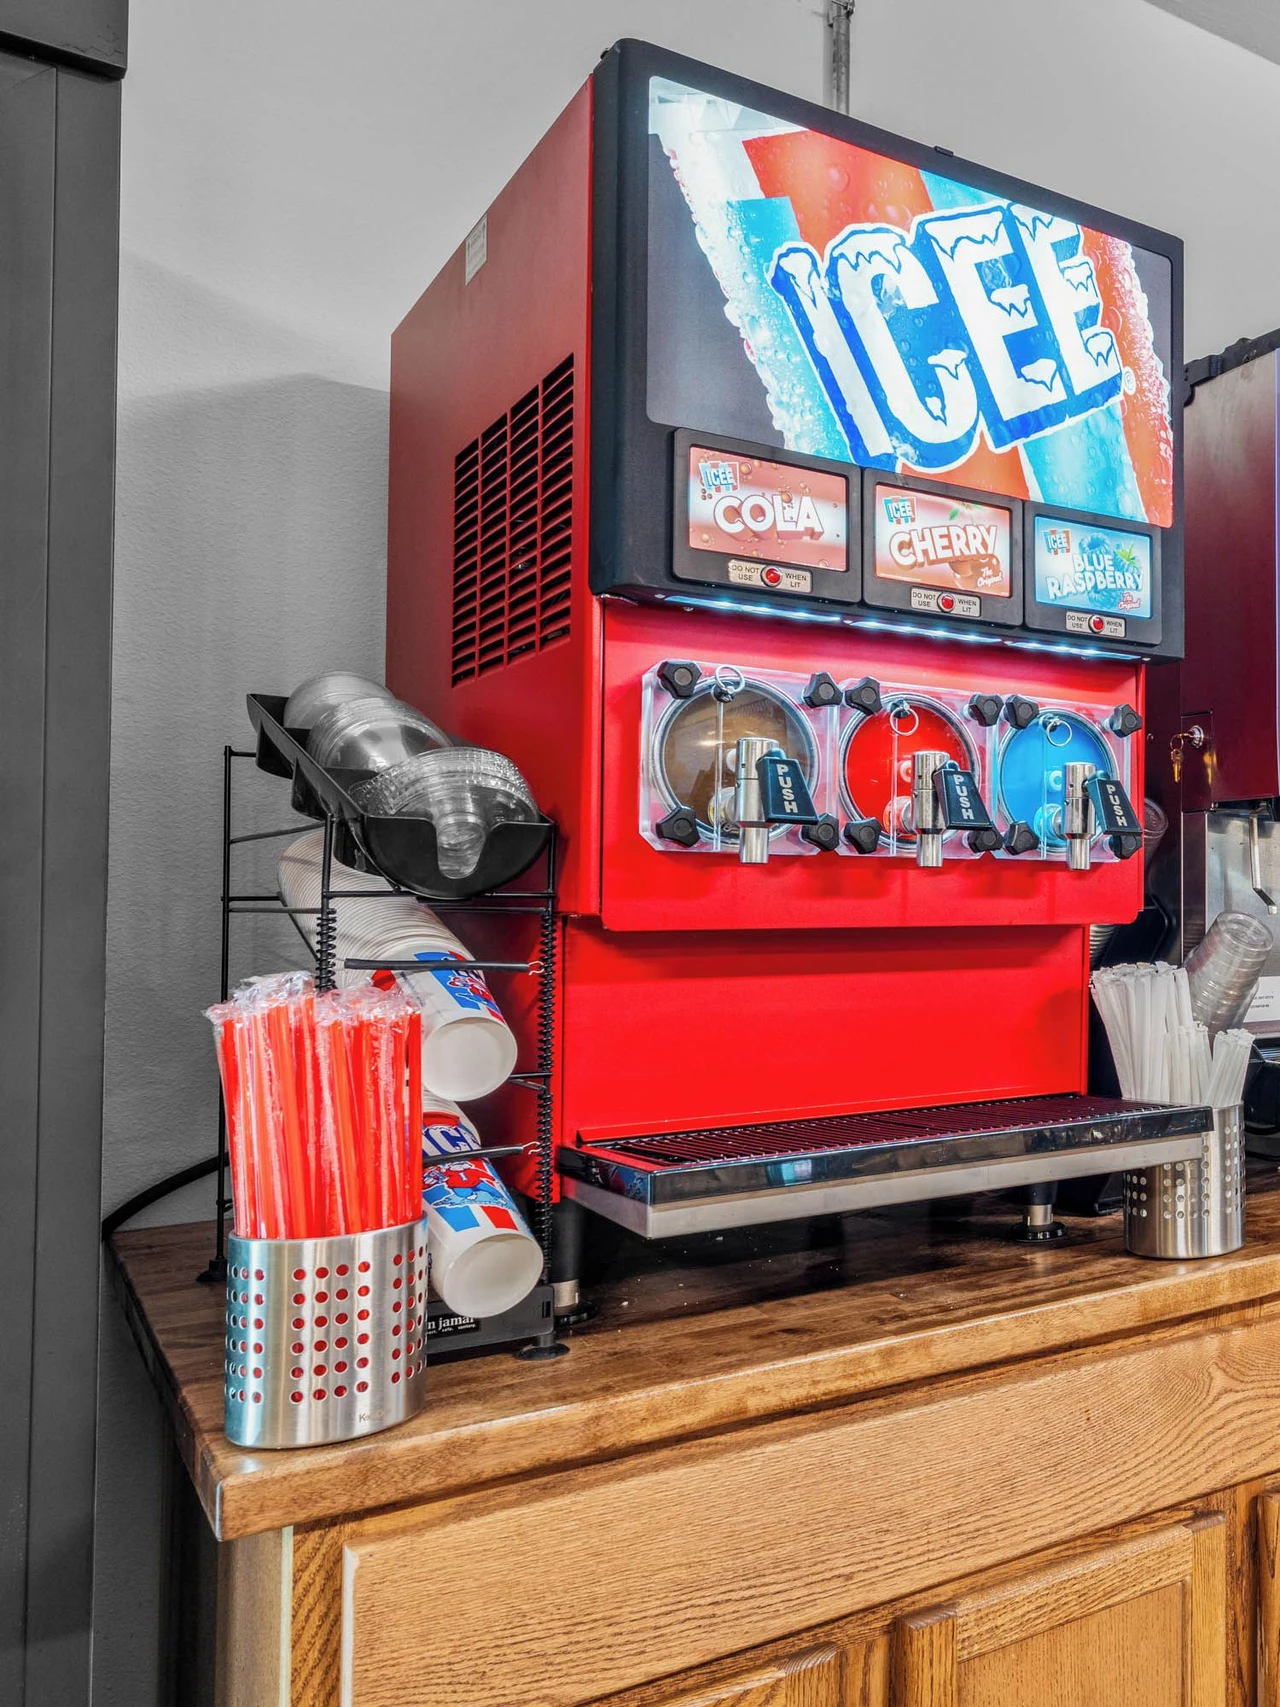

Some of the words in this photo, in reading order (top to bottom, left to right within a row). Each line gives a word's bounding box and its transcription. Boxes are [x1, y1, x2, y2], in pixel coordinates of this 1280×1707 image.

[770, 202, 1123, 468] ICEE
[704, 467, 735, 487] ICEE
[713, 494, 824, 541] COLA
[887, 501, 914, 519] ICEE
[889, 525, 998, 568] CHERRY
[1047, 534, 1069, 550] ICEE
[731, 564, 743, 573] DO
[745, 566, 760, 575] NOT
[1072, 552, 1115, 573] BLUE
[738, 573, 753, 581] USE
[785, 573, 807, 582] WHEN
[790, 580, 801, 588] LIT
[1045, 570, 1143, 600] RASPBERRY
[918, 600, 931, 608] USE
[924, 593, 937, 601] NOT
[957, 598, 977, 607] WHEN
[1106, 620, 1123, 628] WHEN
[1109, 626, 1118, 634] LIT
[775, 763, 799, 814] PUSH
[952, 774, 975, 820] PUSH
[1105, 784, 1128, 827] PUSH
